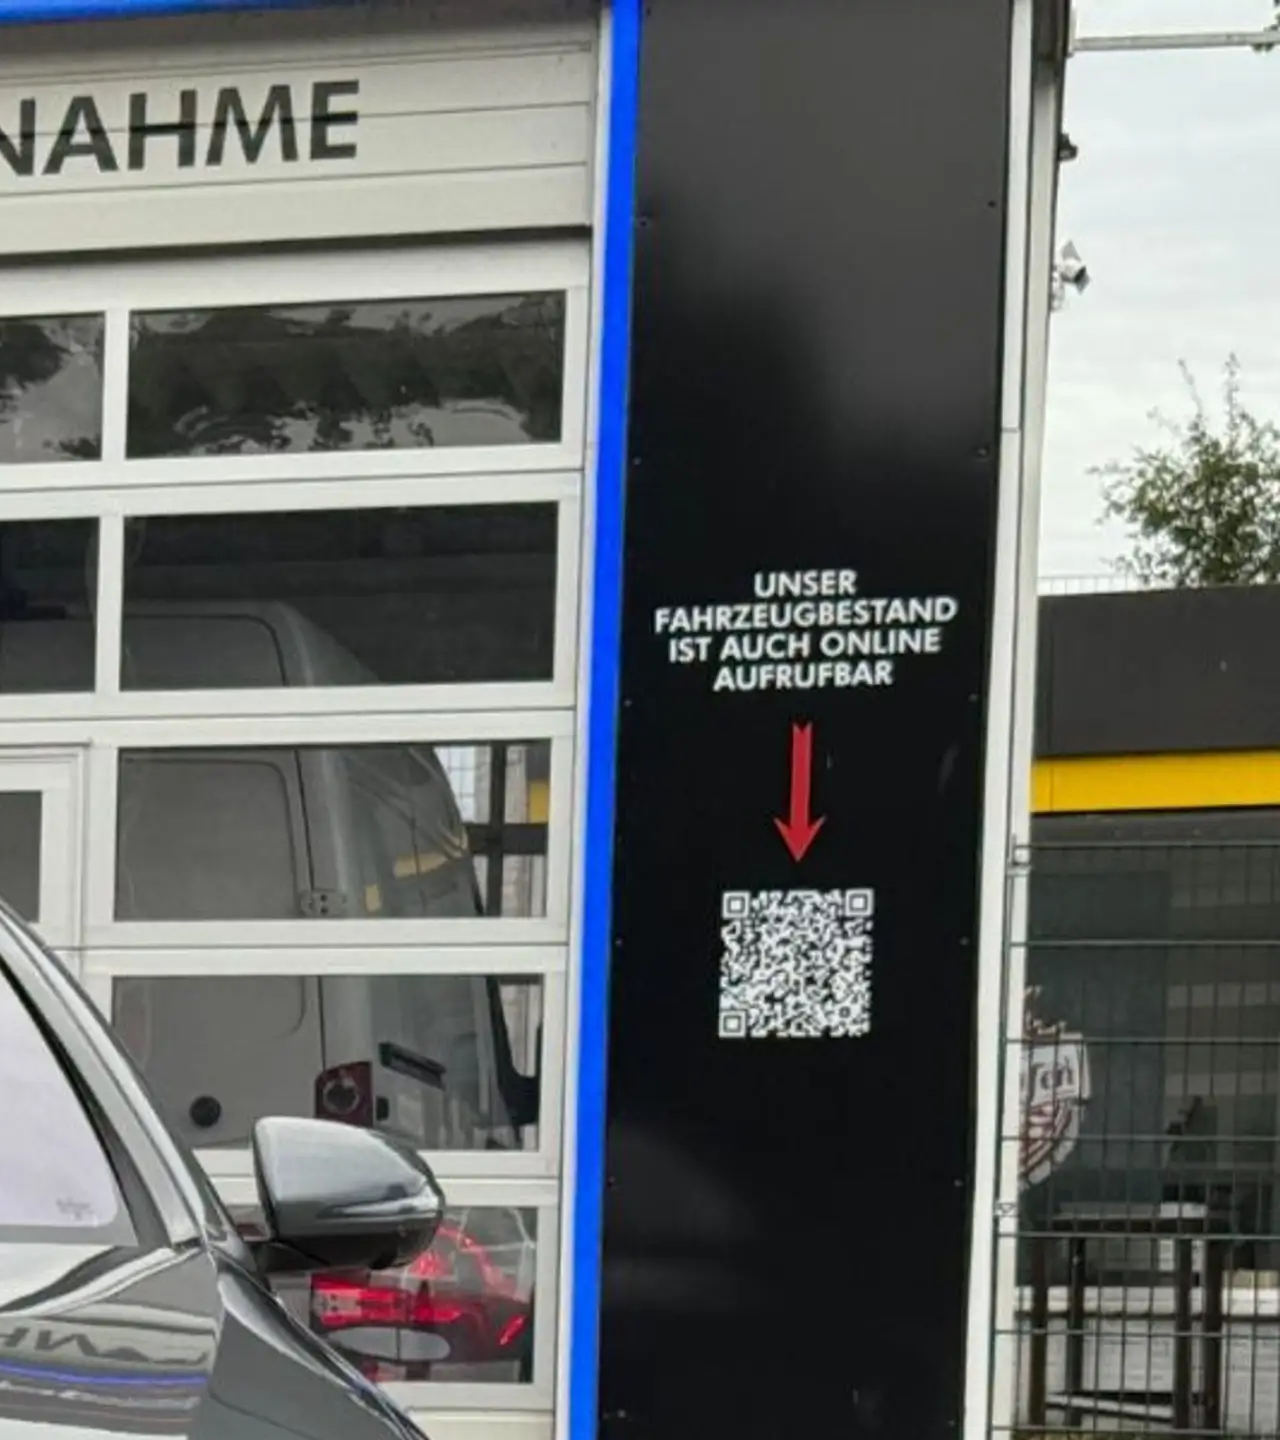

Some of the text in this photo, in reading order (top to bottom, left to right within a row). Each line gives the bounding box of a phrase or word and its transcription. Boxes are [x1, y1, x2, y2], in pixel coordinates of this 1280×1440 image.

[754, 570, 857, 599] UNSER
[654, 598, 958, 634] FAHRZEUGBESTAND
[668, 629, 942, 663] IST AUCH ONLINE
[713, 661, 893, 692] AUFRUFBAR
